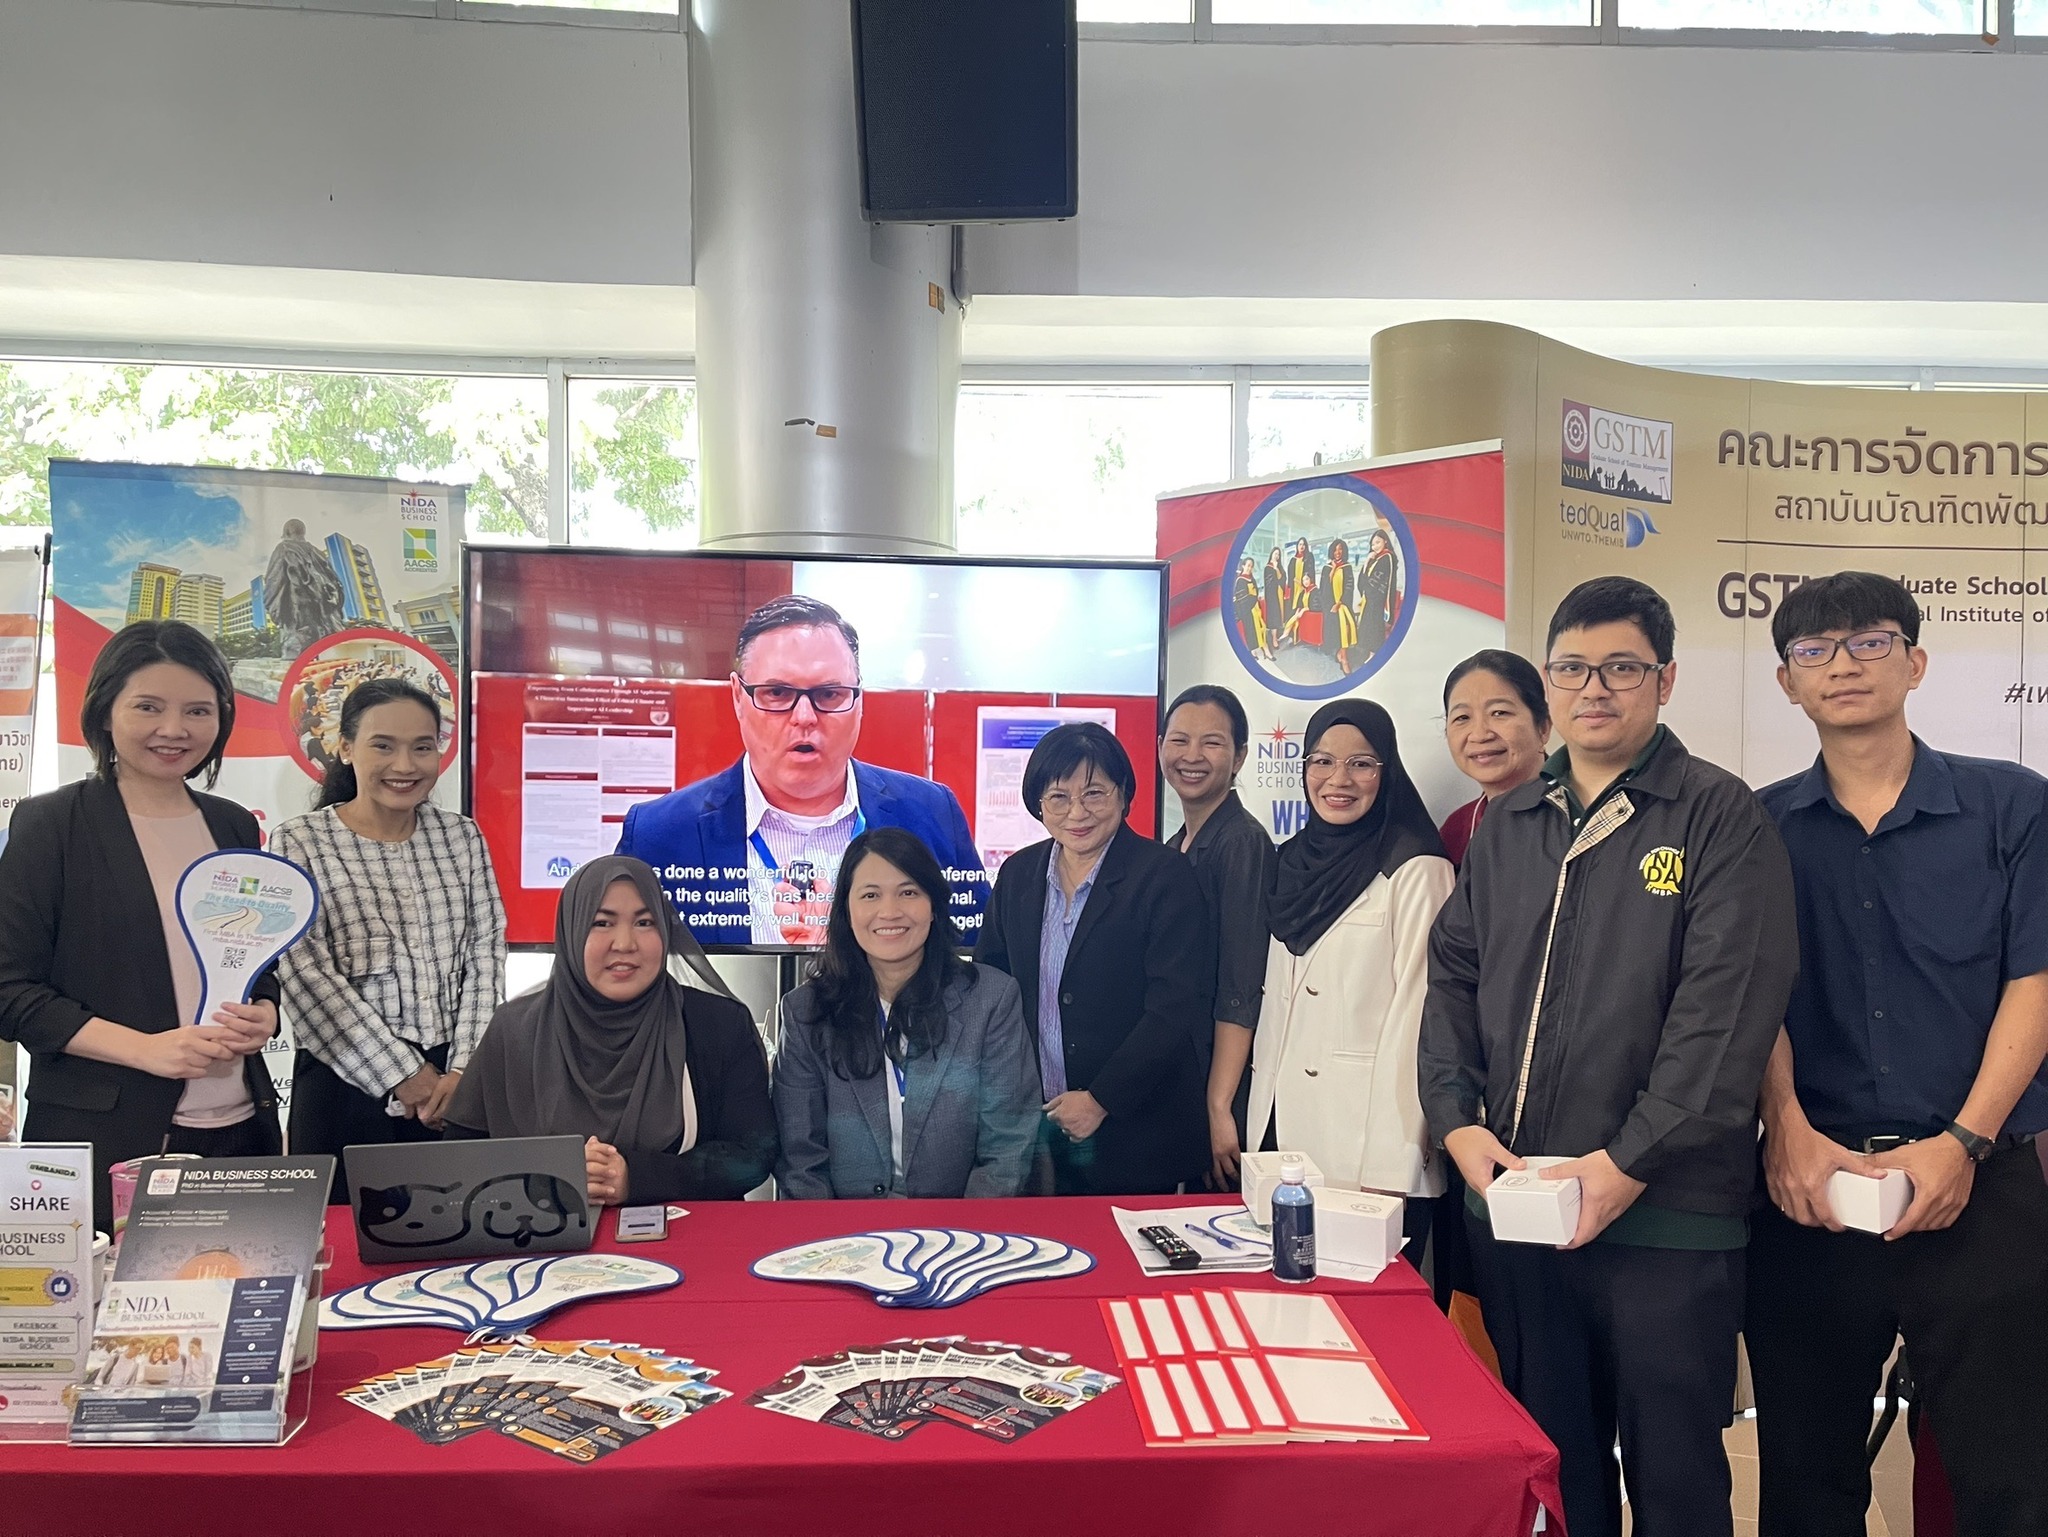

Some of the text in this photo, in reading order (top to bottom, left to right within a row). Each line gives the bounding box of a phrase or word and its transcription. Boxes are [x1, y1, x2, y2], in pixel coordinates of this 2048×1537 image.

[1594, 417, 1667, 460] GSTM
[1563, 463, 1590, 481] NIDA
[401, 498, 436, 507] NIDA
[401, 506, 438, 515] BUSINESS
[401, 513, 438, 521] SCHOOL
[1560, 499, 1624, 532] tedQual
[404, 559, 438, 568] AACSB
[1967, 576, 2048, 596] School
[1718, 571, 1810, 619] GST
[1941, 606, 2023, 623] Institute
[2032, 608, 2048, 623] o
[1258, 741, 1303, 759] NID
[1257, 761, 1303, 774] BUSINE
[213, 874, 238, 884] NIDA
[664, 864, 705, 880] done
[708, 867, 719, 880] a
[723, 863, 800, 881] wonderful
[801, 864, 828, 883] job
[260, 885, 293, 896] AACSB
[675, 887, 702, 903] the
[704, 887, 769, 906] quality's
[773, 888, 802, 903] has
[949, 889, 977, 905] nal.
[257, 899, 292, 914] Quality
[688, 910, 766, 930] extremely
[769, 911, 800, 926] well
[803, 914, 831, 927] ma
[219, 929, 236, 939] MBA
[183, 1168, 318, 1181] NIDA BUSINESS SCHOOL
[9, 1195, 71, 1212] SHARE
[123, 1296, 170, 1313] NIDA
[166, 1311, 206, 1321] SCHOOL
[13, 1321, 58, 1331] FACEBOOK
